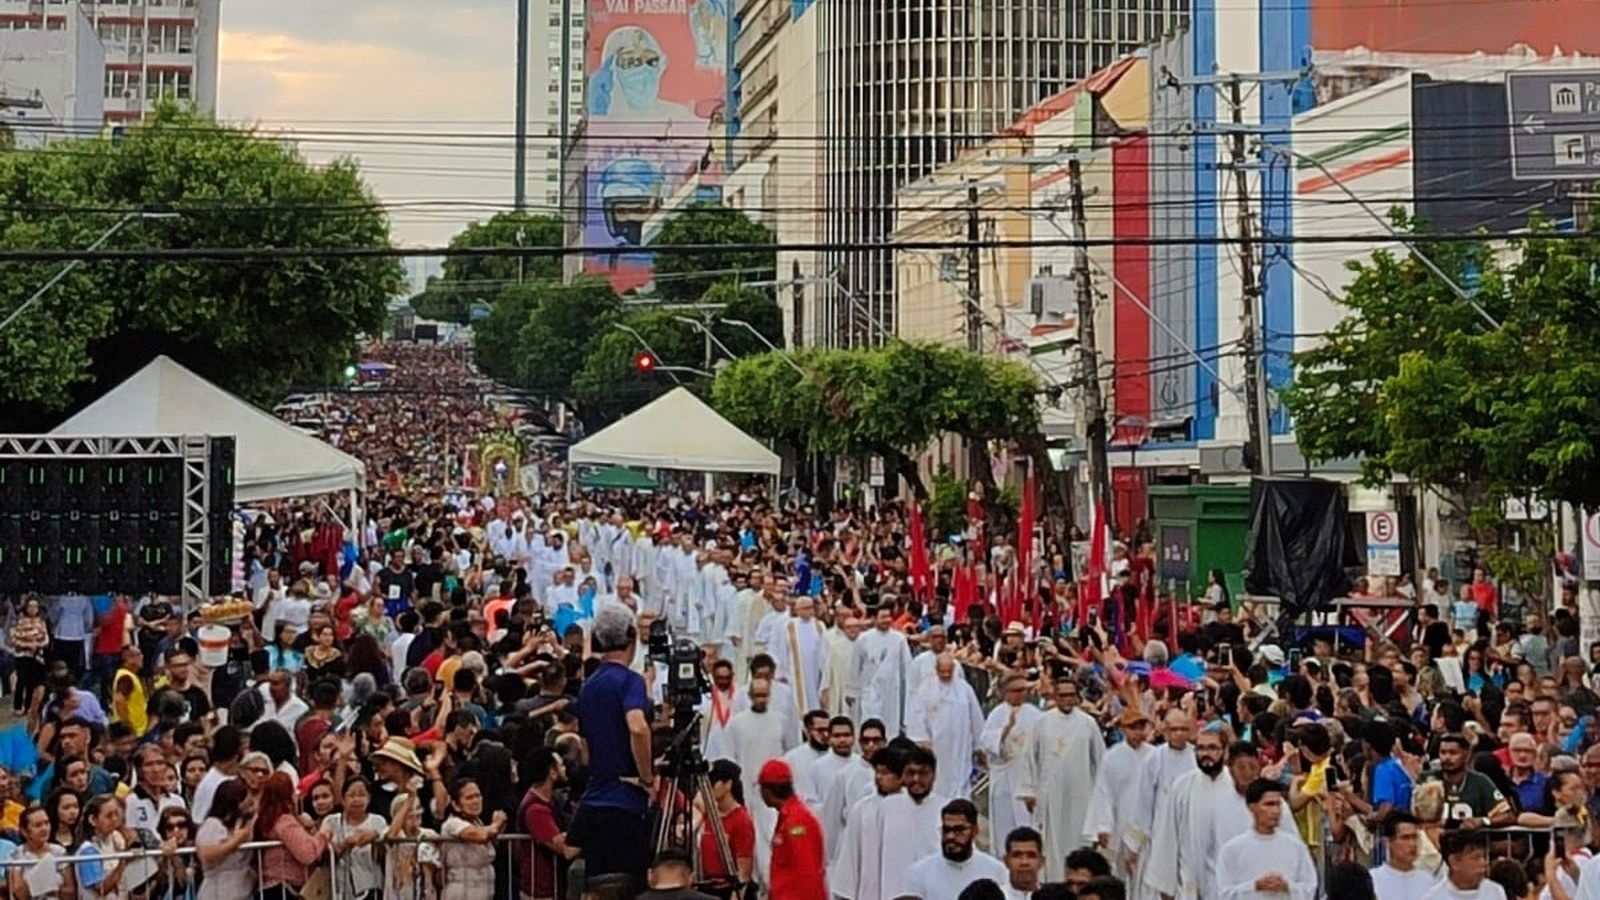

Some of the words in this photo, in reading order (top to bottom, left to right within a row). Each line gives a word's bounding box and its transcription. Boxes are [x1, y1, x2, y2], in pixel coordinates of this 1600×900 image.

[607, 0, 629, 13] VAI
[634, 0, 687, 14] PASSAR
[1377, 519, 1388, 536] E
[136, 806, 148, 821] 3
